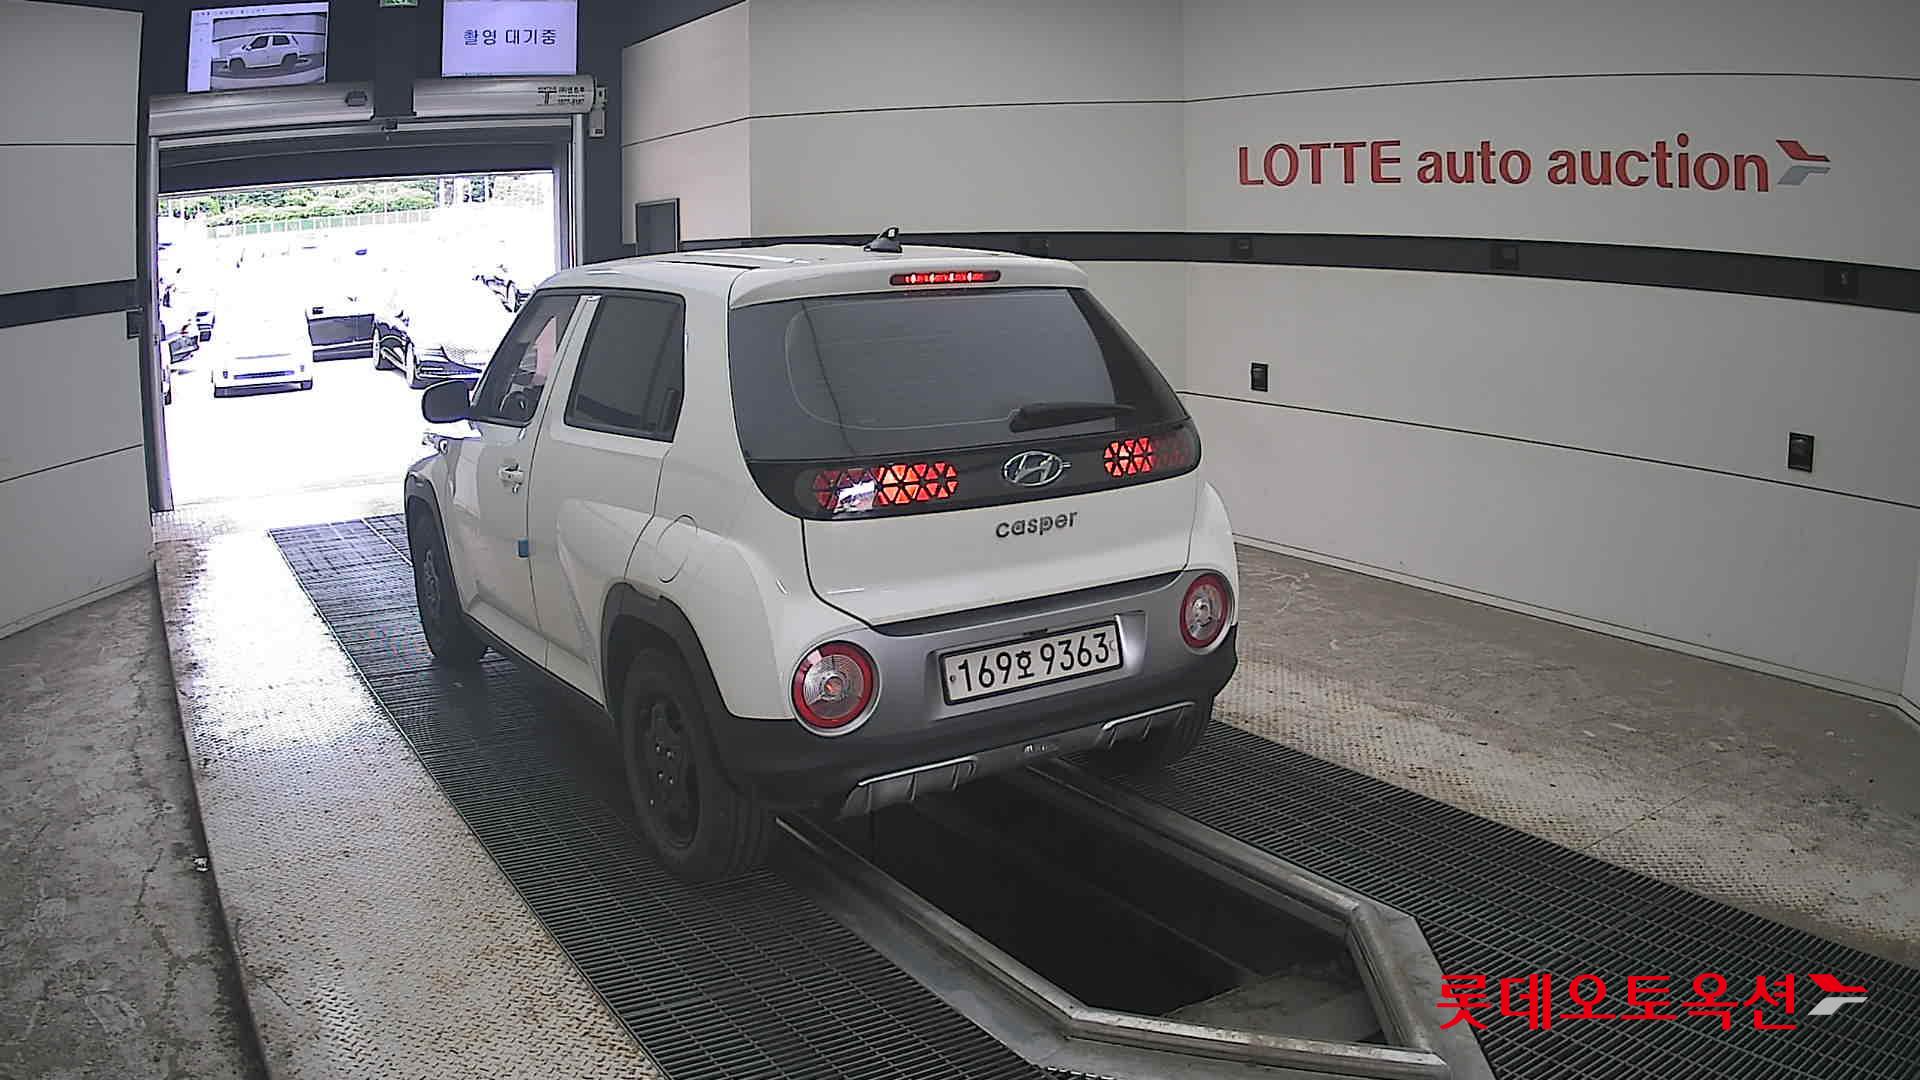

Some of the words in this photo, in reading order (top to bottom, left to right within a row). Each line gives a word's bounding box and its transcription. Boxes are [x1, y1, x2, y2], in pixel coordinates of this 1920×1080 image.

[464, 29, 497, 46] 촬영
[505, 29, 556, 45] 대기중
[1238, 139, 1401, 186] LOTTE
[1416, 140, 1532, 185] auto
[1547, 132, 1769, 192] auction
[995, 511, 1078, 538] casper
[958, 650, 1035, 692] 169호
[1040, 632, 1109, 676] 9363
